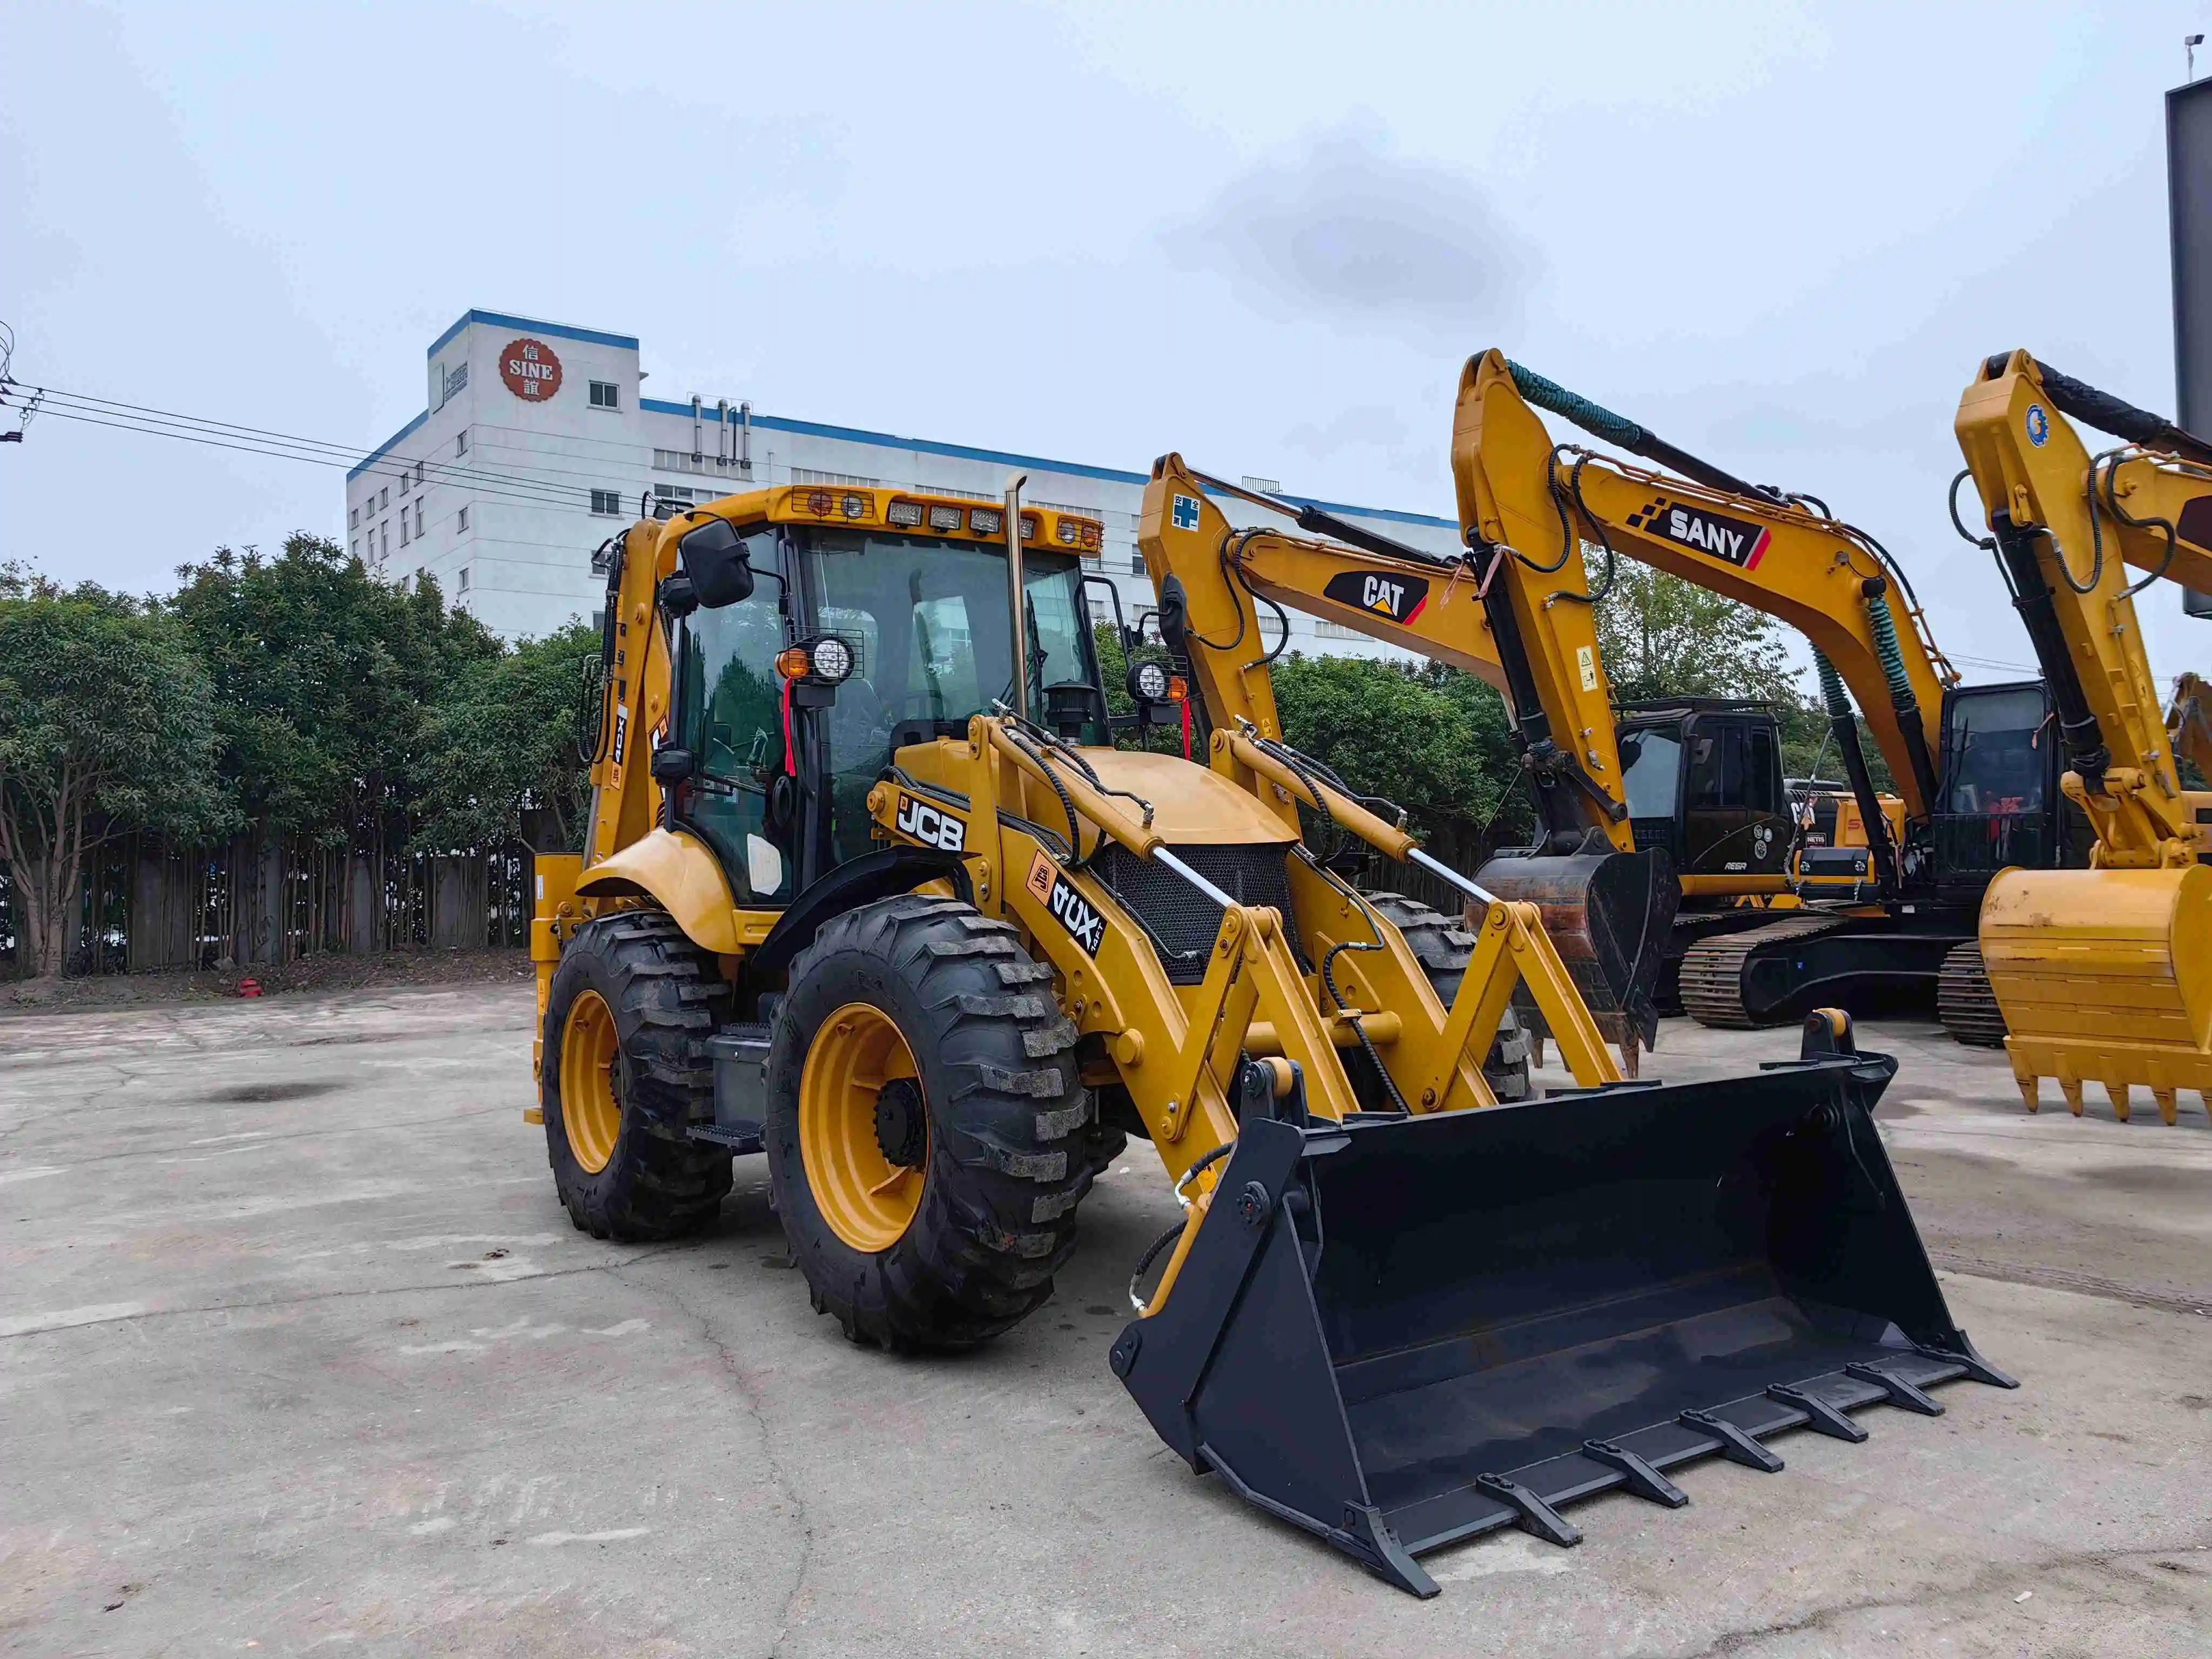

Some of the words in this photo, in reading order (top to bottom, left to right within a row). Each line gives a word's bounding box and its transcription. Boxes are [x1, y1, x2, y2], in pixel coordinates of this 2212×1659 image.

[522, 345, 538, 360] 信
[509, 359, 553, 381] SINE
[1670, 509, 1744, 559] SANY
[1363, 575, 1404, 617] CAT
[898, 801, 963, 851] JCB
[1035, 867, 1048, 890] JCB
